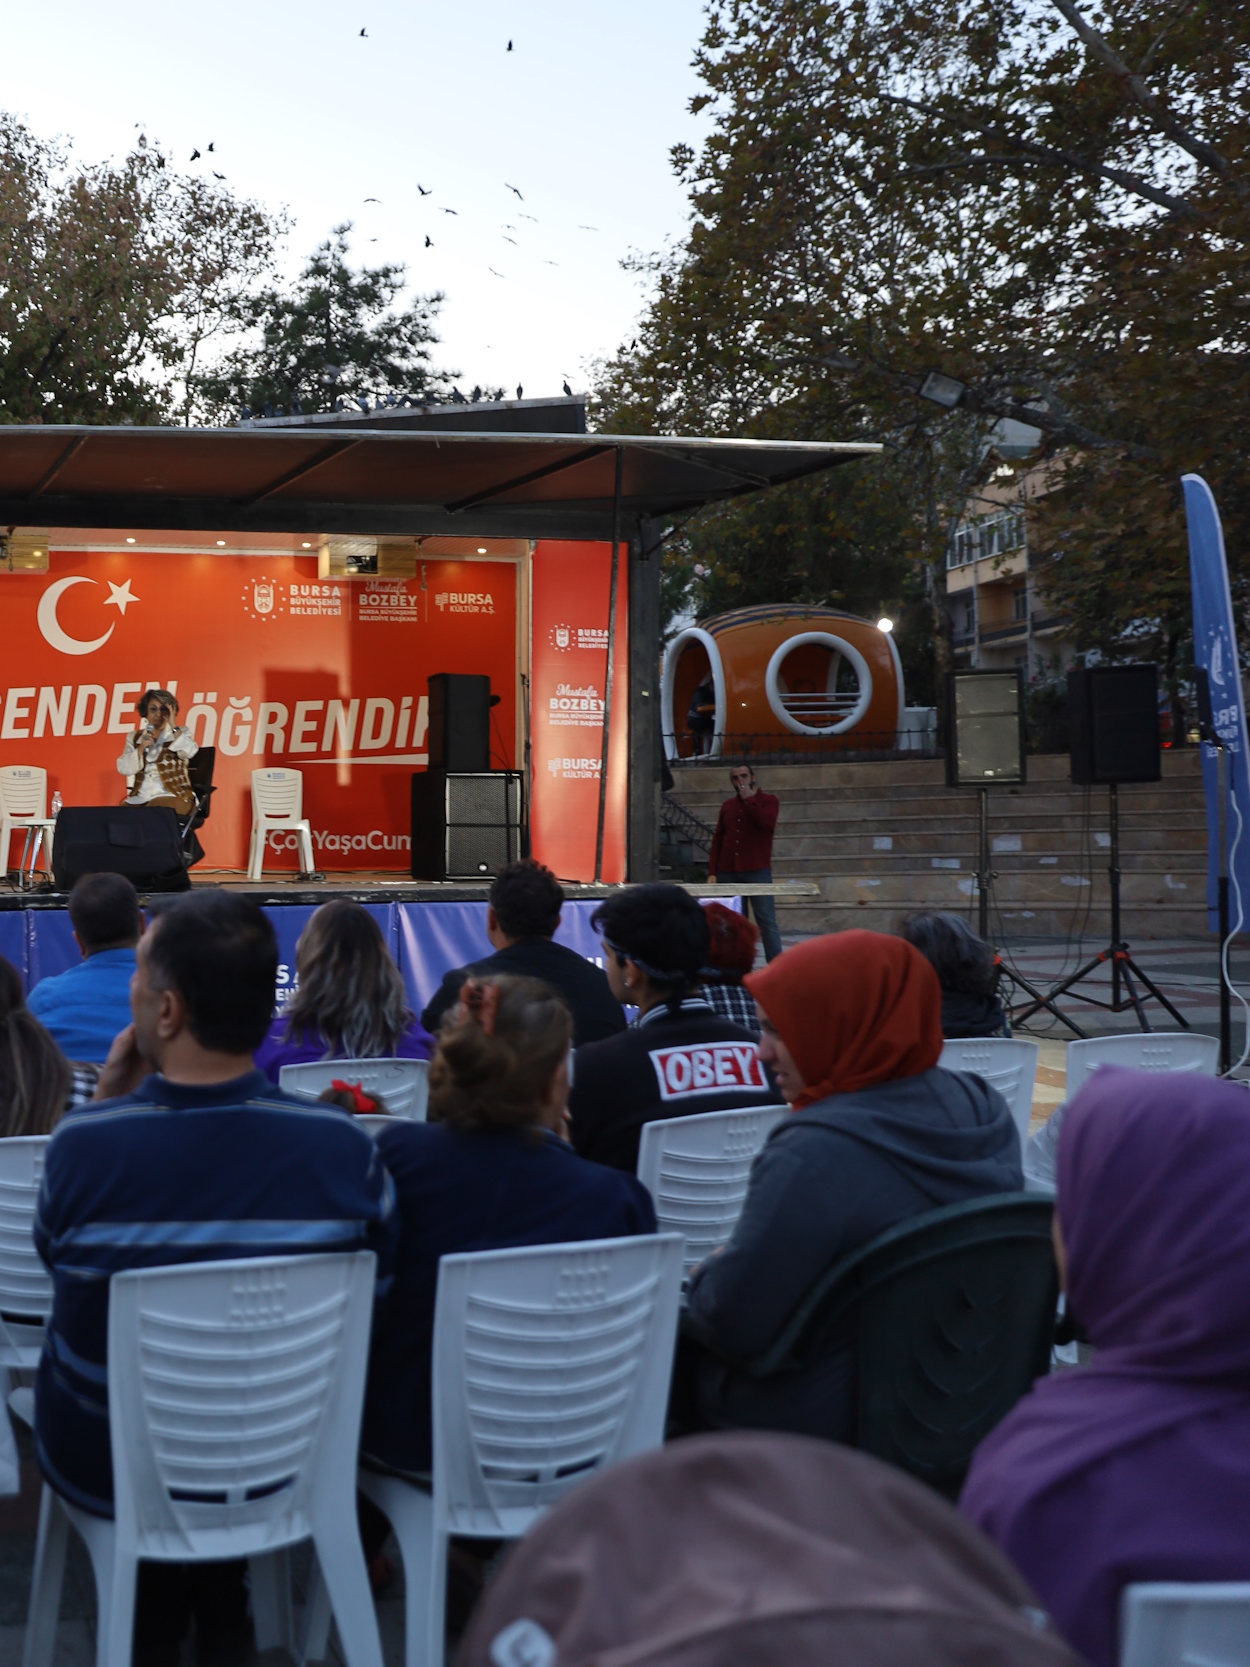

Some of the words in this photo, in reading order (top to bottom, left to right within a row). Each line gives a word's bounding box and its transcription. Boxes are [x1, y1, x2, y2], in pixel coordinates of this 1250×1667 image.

[290, 584, 341, 596] BURSA
[365, 581, 407, 596] Mustafa
[290, 596, 341, 606] BÜYÜKŞEHİR
[359, 594, 417, 606] BOZBEY
[450, 592, 493, 604] BURSA
[290, 605, 342, 615] BELEDİYESİ
[450, 604, 479, 613] KÜLTÜR
[578, 629, 609, 637] BURSA
[556, 684, 598, 699] Mustafa
[550, 698, 606, 710] BOZBEY
[562, 770, 592, 778] KÜLTÜR
[665, 1047, 754, 1092] OBEY
